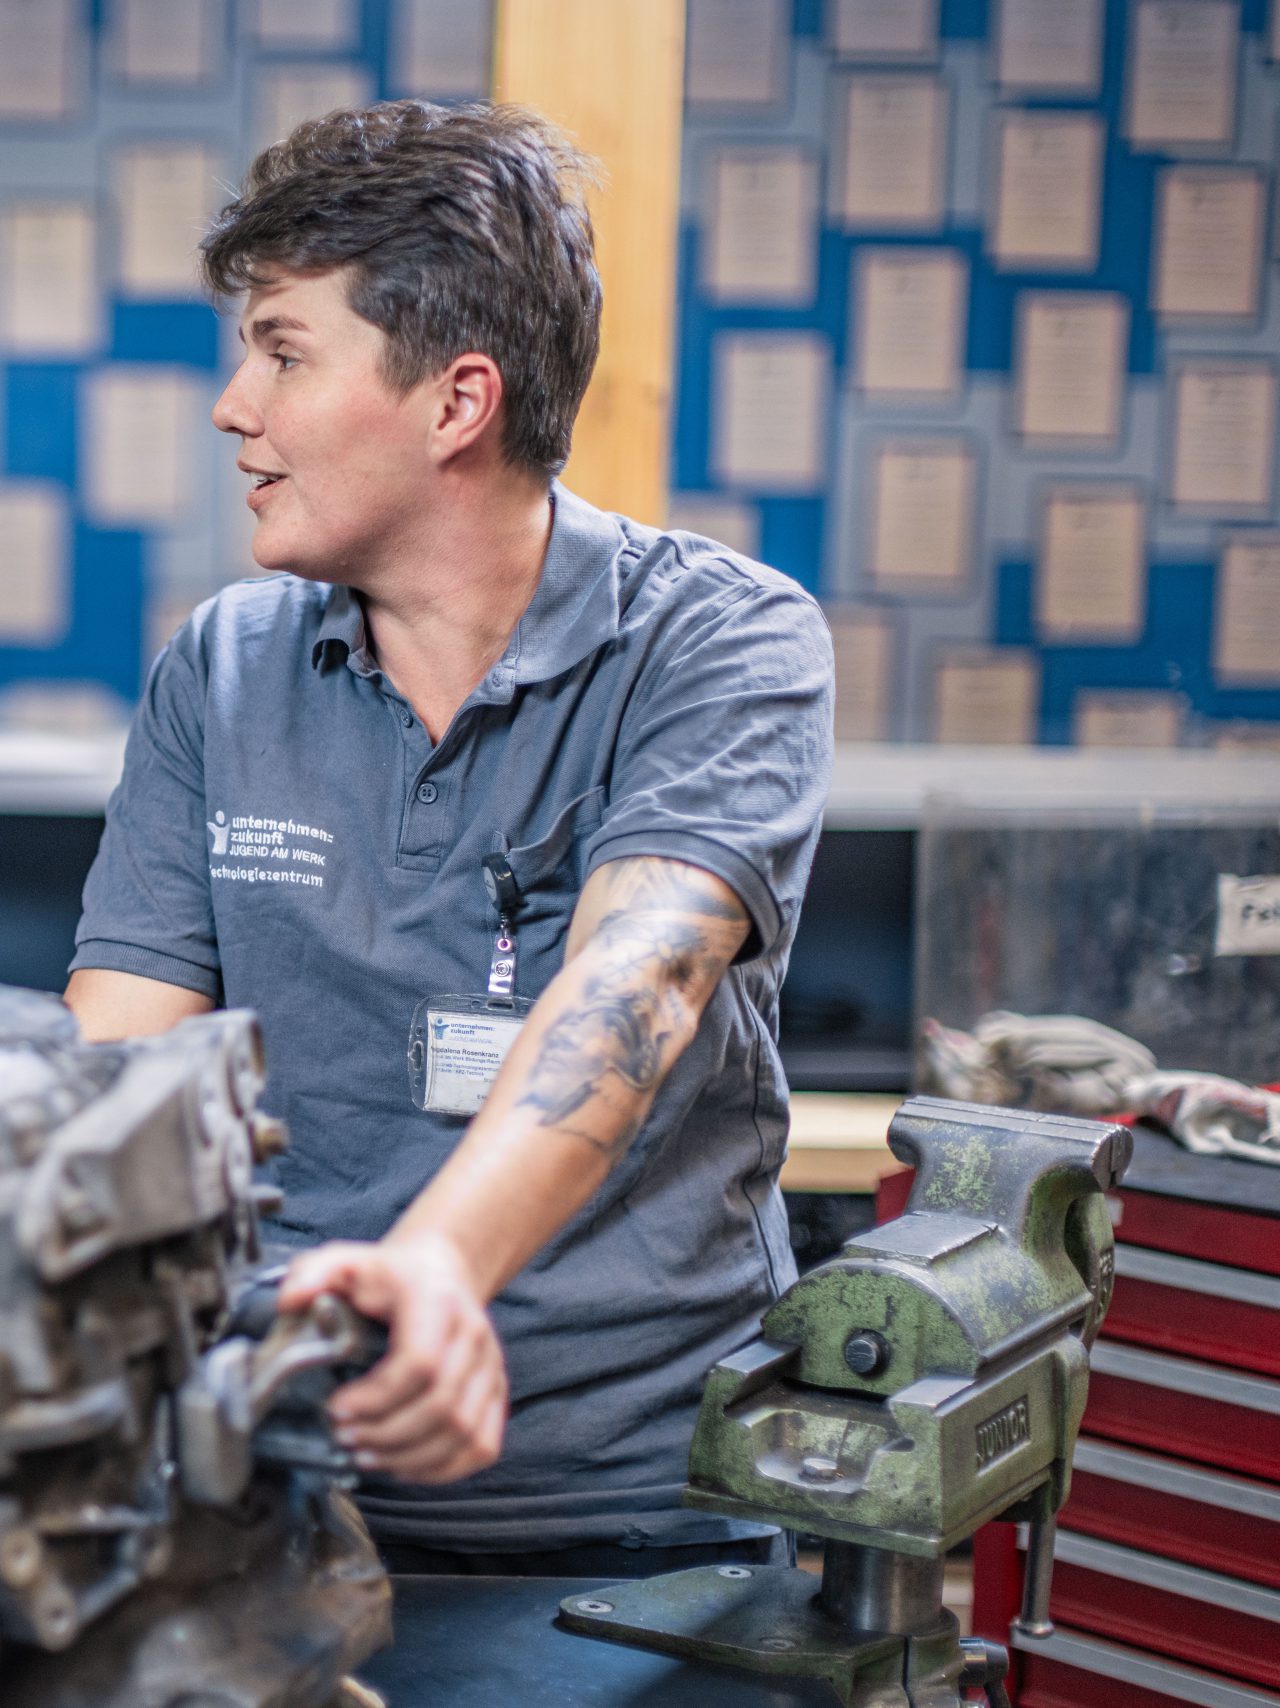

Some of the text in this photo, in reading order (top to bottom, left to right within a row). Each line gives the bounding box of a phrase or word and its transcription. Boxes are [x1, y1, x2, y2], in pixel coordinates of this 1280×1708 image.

[230, 829, 284, 845] zukunft
[229, 843, 326, 866] JUGEND AM WERK
[209, 865, 323, 887] echnologiezentrum
[462, 1048, 499, 1058] Rosenkranz
[975, 1402, 1028, 1464] JUNIOR
